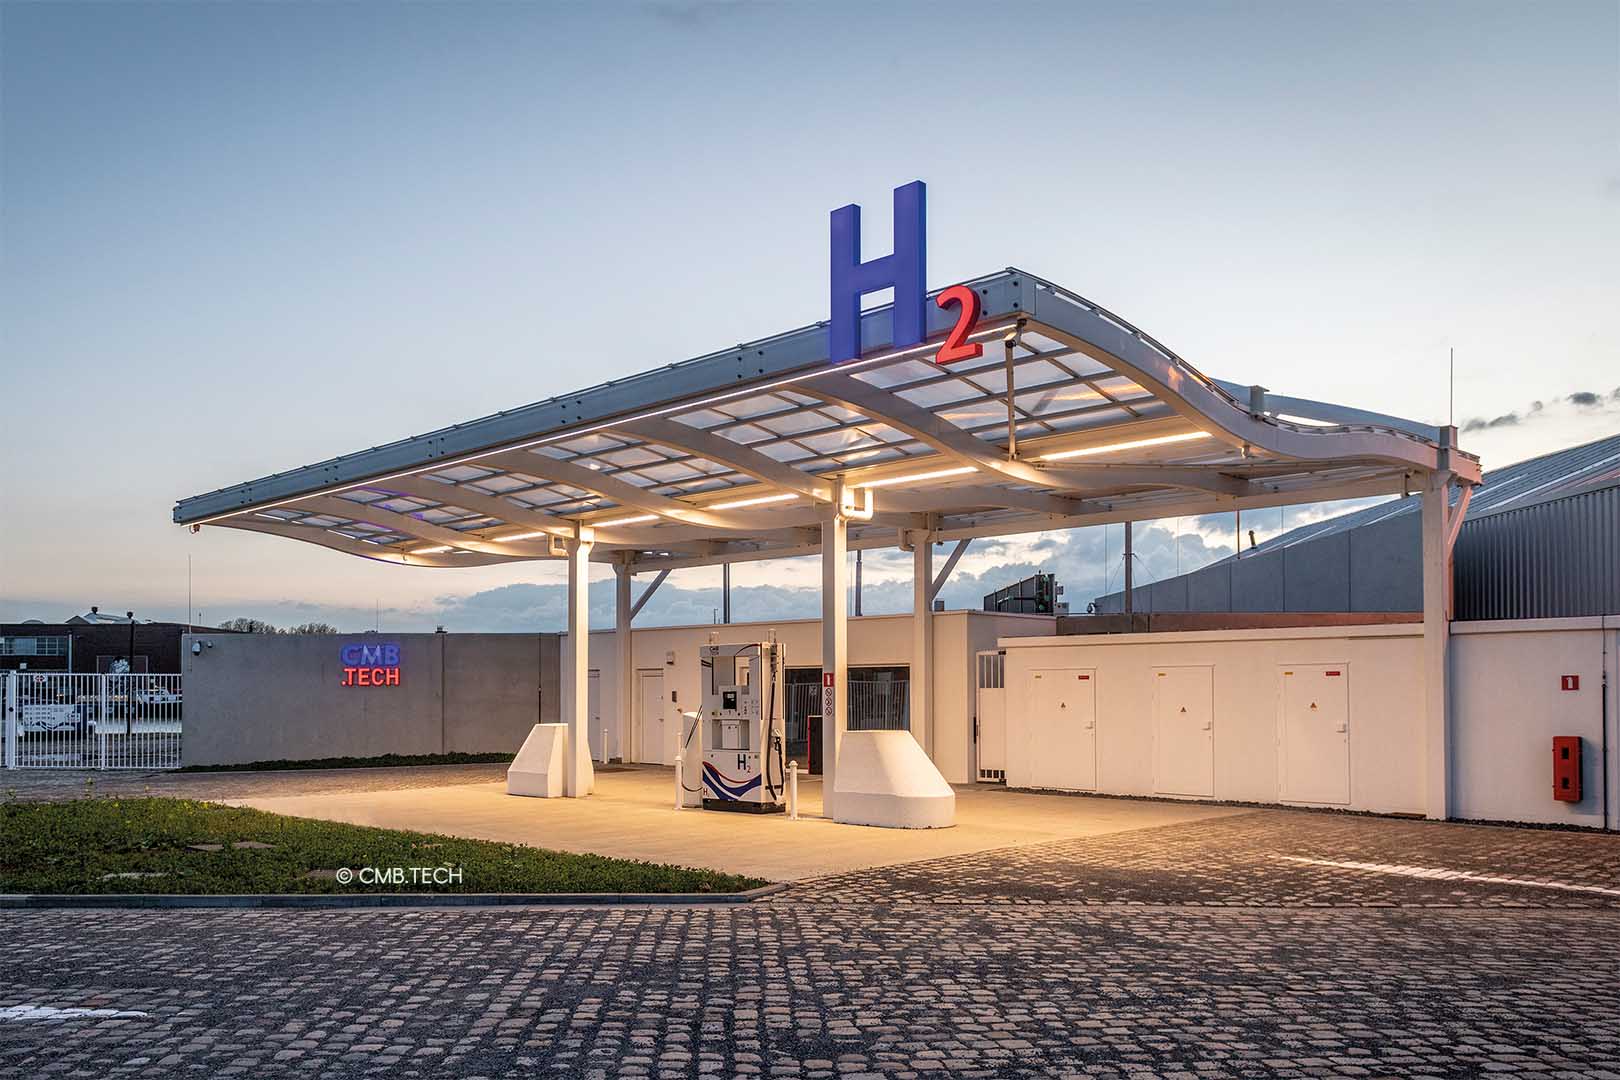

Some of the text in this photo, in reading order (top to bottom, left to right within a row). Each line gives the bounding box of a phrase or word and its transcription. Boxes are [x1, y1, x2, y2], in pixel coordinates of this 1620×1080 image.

[831, 180, 983, 364] H2
[341, 644, 399, 665] CMB
[342, 668, 399, 685] .TECH
